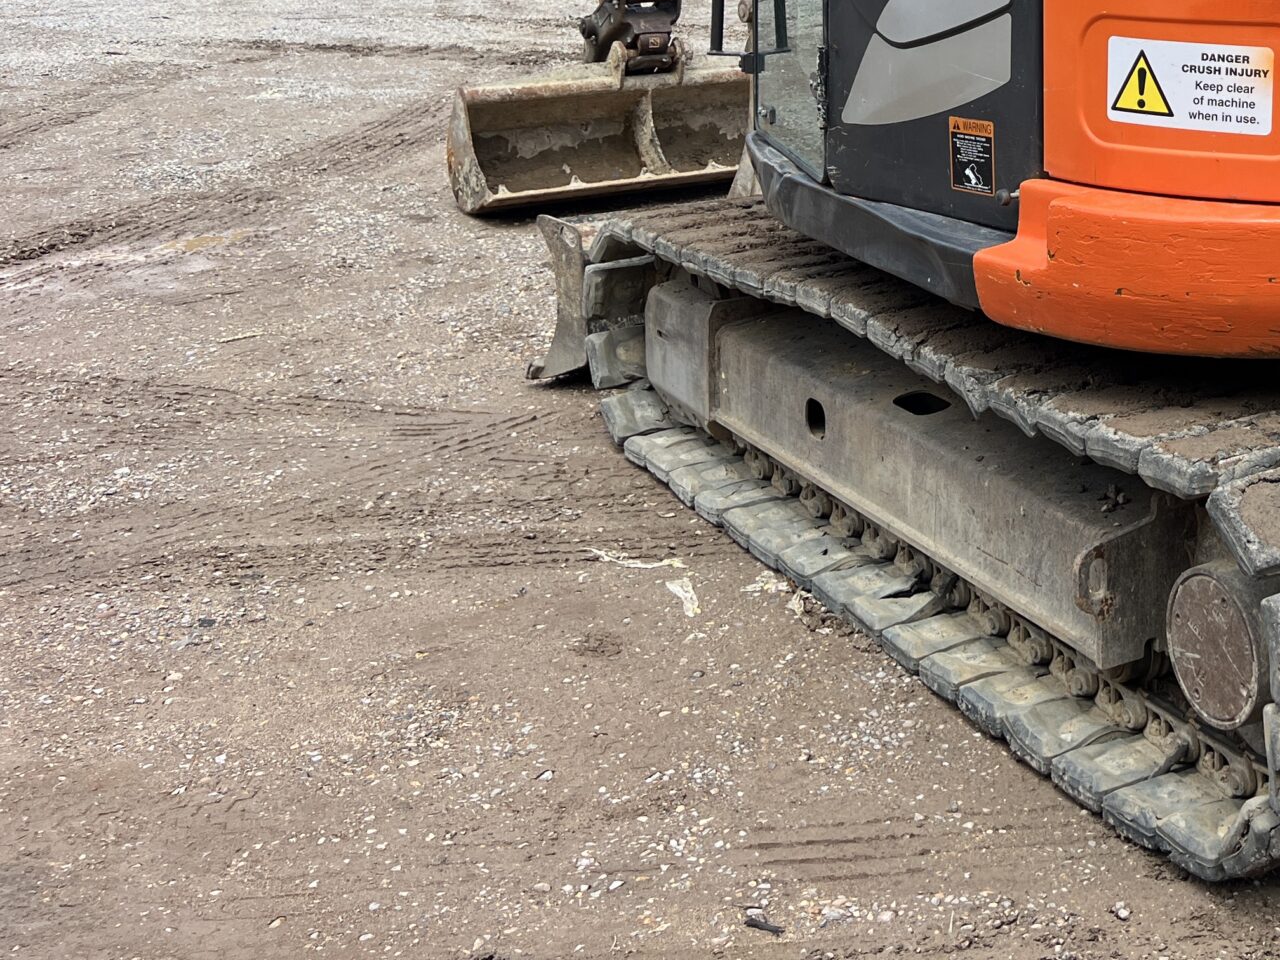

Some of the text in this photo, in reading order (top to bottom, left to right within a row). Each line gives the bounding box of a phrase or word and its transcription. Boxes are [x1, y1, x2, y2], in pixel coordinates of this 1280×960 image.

[1201, 52, 1250, 64] DANGER
[1181, 63, 1270, 78] CRUSH INJURY
[1195, 80, 1255, 94] Keep clear
[1192, 95, 1256, 109] of machine
[1188, 110, 1260, 124] when in use.
[962, 120, 992, 134] WARNING
